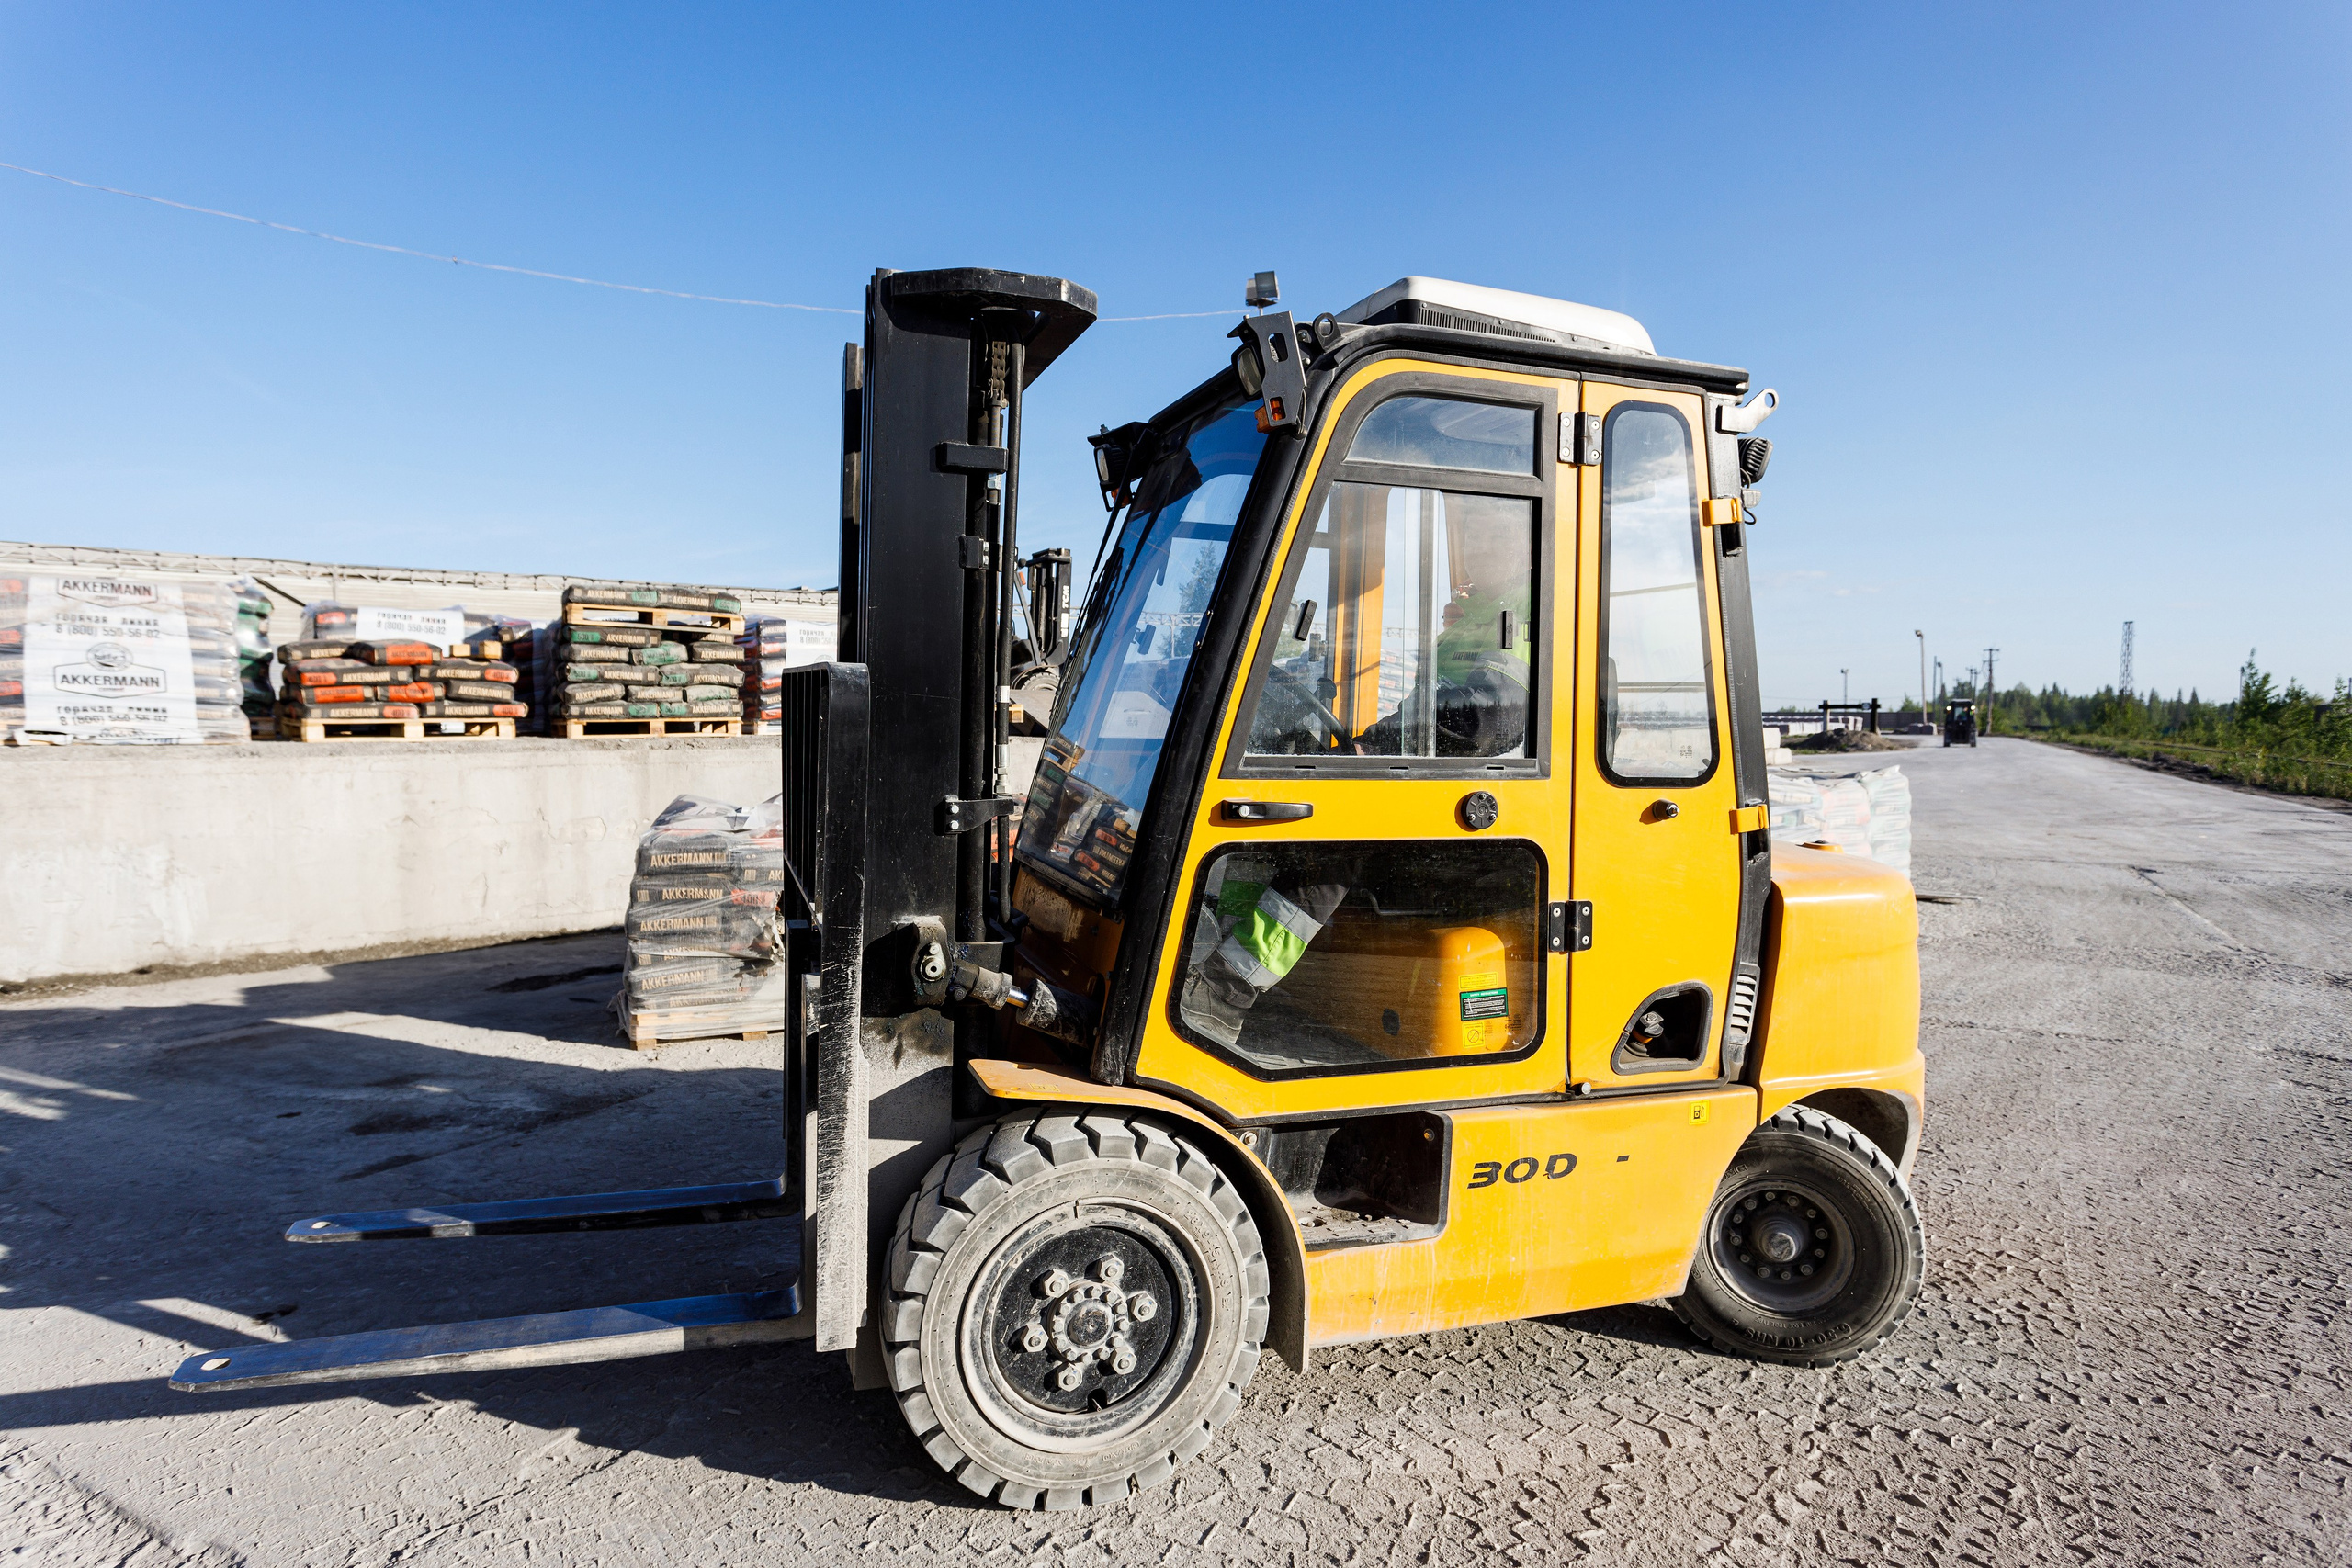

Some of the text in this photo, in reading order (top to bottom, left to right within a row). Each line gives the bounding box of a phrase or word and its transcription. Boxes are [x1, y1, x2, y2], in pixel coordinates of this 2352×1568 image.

[62, 580, 153, 596] AKKERMANN
[588, 589, 626, 599] AKKERMANN
[1062, 585, 1070, 609] TCM
[673, 596, 709, 607] AKKERMANN
[607, 634, 645, 644] AKKERMANN
[580, 649, 619, 659] AKKERMANN
[701, 650, 736, 660] AKKERMANN
[343, 672, 390, 683] AKKERMANN
[436, 669, 481, 679] AKKERMANN
[604, 671, 643, 681] AKKERMANN
[694, 675, 729, 683] AKKERMANN
[60, 675, 160, 688] AKKERMANN
[458, 686, 502, 698] AKKERMANN
[575, 689, 615, 701] AKKERMANN
[637, 691, 674, 700] AKKERMANN
[331, 708, 379, 717] AKKERMANN
[445, 706, 489, 716] AKKERMANN
[585, 706, 623, 716] AKKERMANN
[692, 705, 729, 714] AKKERMANN
[650, 852, 714, 867] AKKERMANN
[662, 888, 723, 900] AKKERMANN
[640, 917, 704, 932] AKKERMANN
[642, 970, 704, 991] AKKERMANN
[1467, 1153, 1577, 1189] 30D
[1745, 1326, 1780, 1347] NHS
